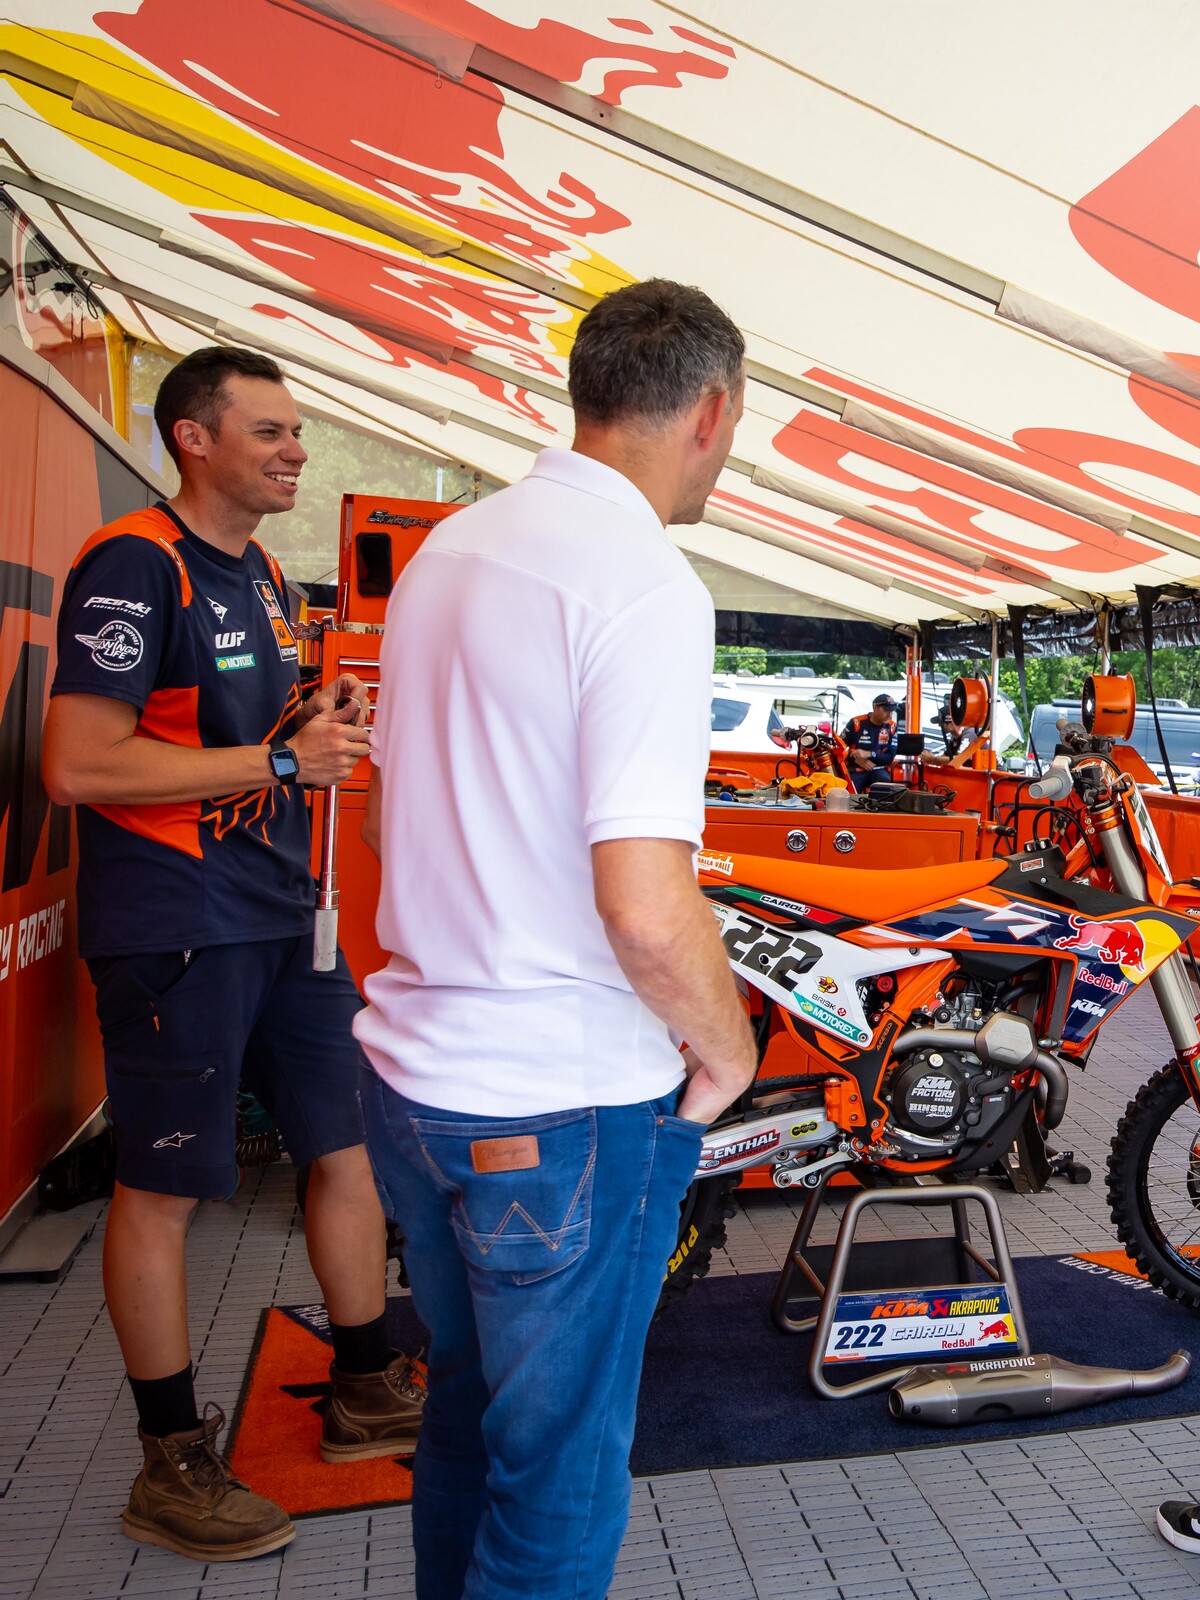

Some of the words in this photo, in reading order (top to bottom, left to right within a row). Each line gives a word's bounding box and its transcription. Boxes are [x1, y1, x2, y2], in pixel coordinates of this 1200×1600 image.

[101, 640, 139, 656] WINGS
[215, 631, 246, 649] WP
[761, 895, 809, 914] CAIROLI
[16, 899, 66, 972] RACING
[721, 915, 824, 993] 222
[1077, 968, 1103, 989] Red
[1102, 975, 1128, 996] Bull
[811, 993, 836, 1011] BRISK
[1071, 999, 1107, 1017] KTM
[813, 1007, 857, 1037] MOTOREX
[916, 1076, 953, 1089] KTM
[911, 1088, 956, 1098] FACTORY
[909, 1103, 954, 1113] HINSON
[870, 1299, 930, 1318] KTM
[949, 1296, 1000, 1316] AKRAPOVIČ
[834, 1323, 887, 1350] 222
[890, 1323, 966, 1341] CAIROLI
[941, 1339, 958, 1349] Red
[959, 1338, 975, 1348] Bull
